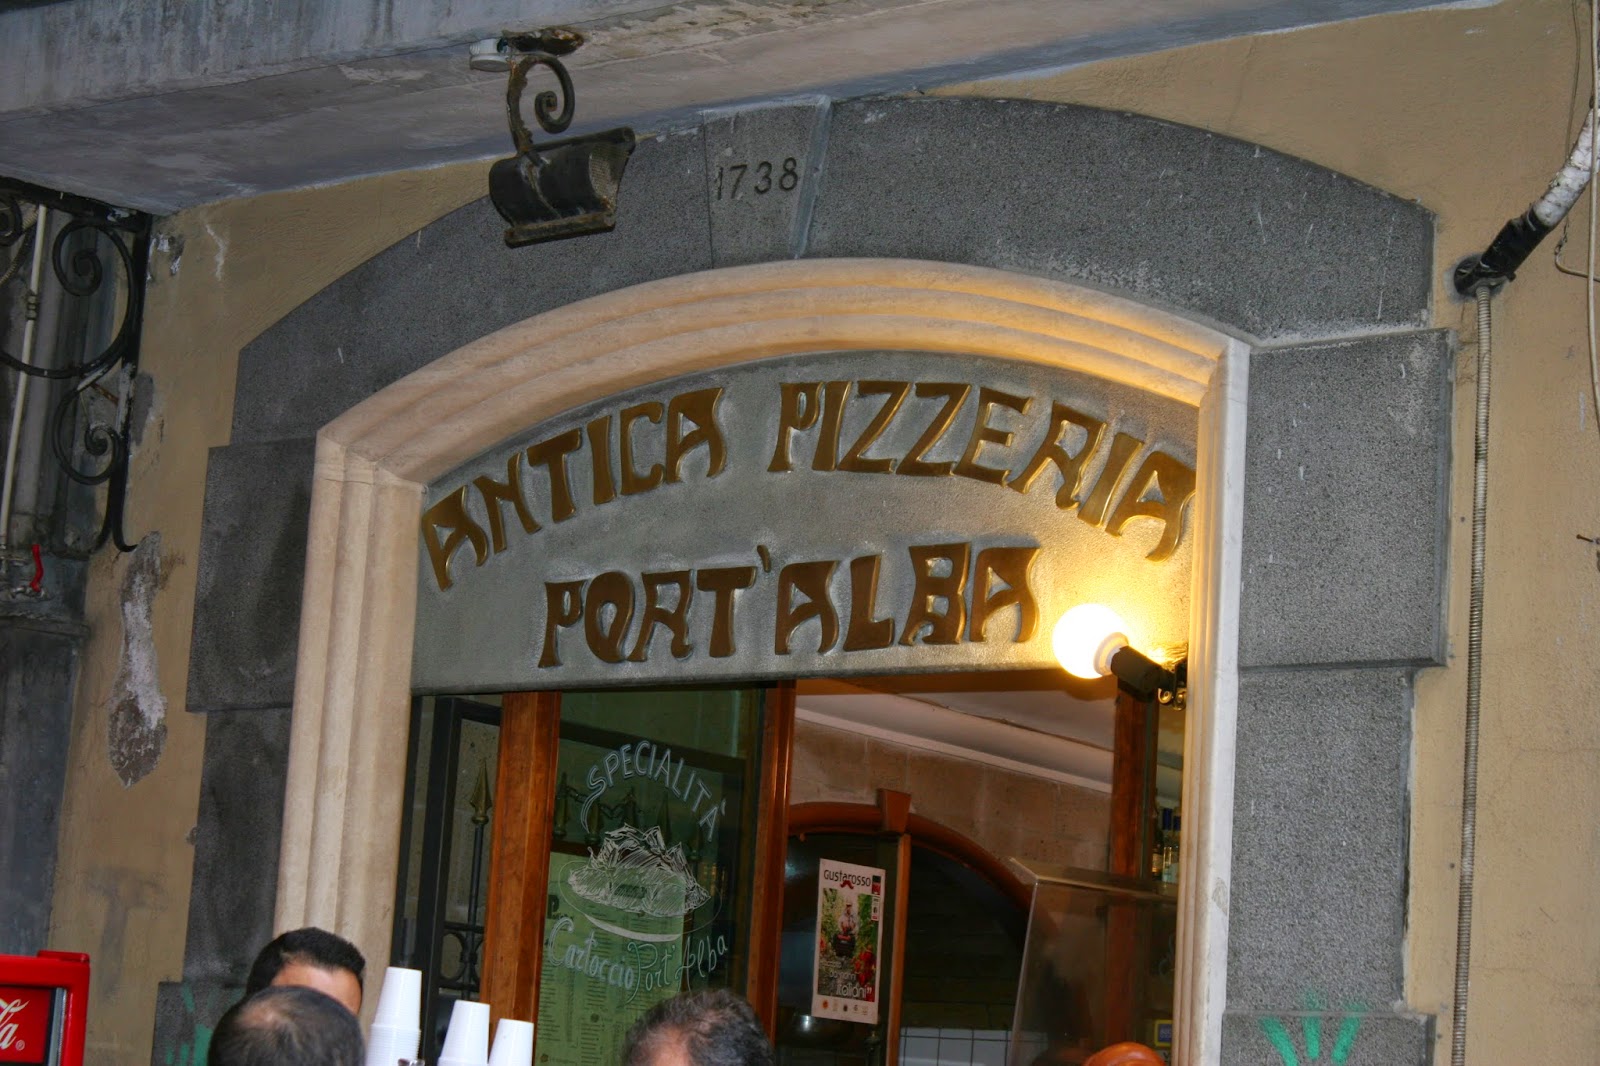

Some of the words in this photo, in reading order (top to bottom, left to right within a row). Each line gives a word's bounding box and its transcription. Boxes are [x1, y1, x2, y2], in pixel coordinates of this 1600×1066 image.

[716, 157, 798, 200] 1738
[421, 387, 728, 592] ANTICA
[767, 380, 1197, 563] PIZZERIA
[538, 542, 1041, 668] PORT'ALBA
[548, 916, 635, 990] Cartoccio
